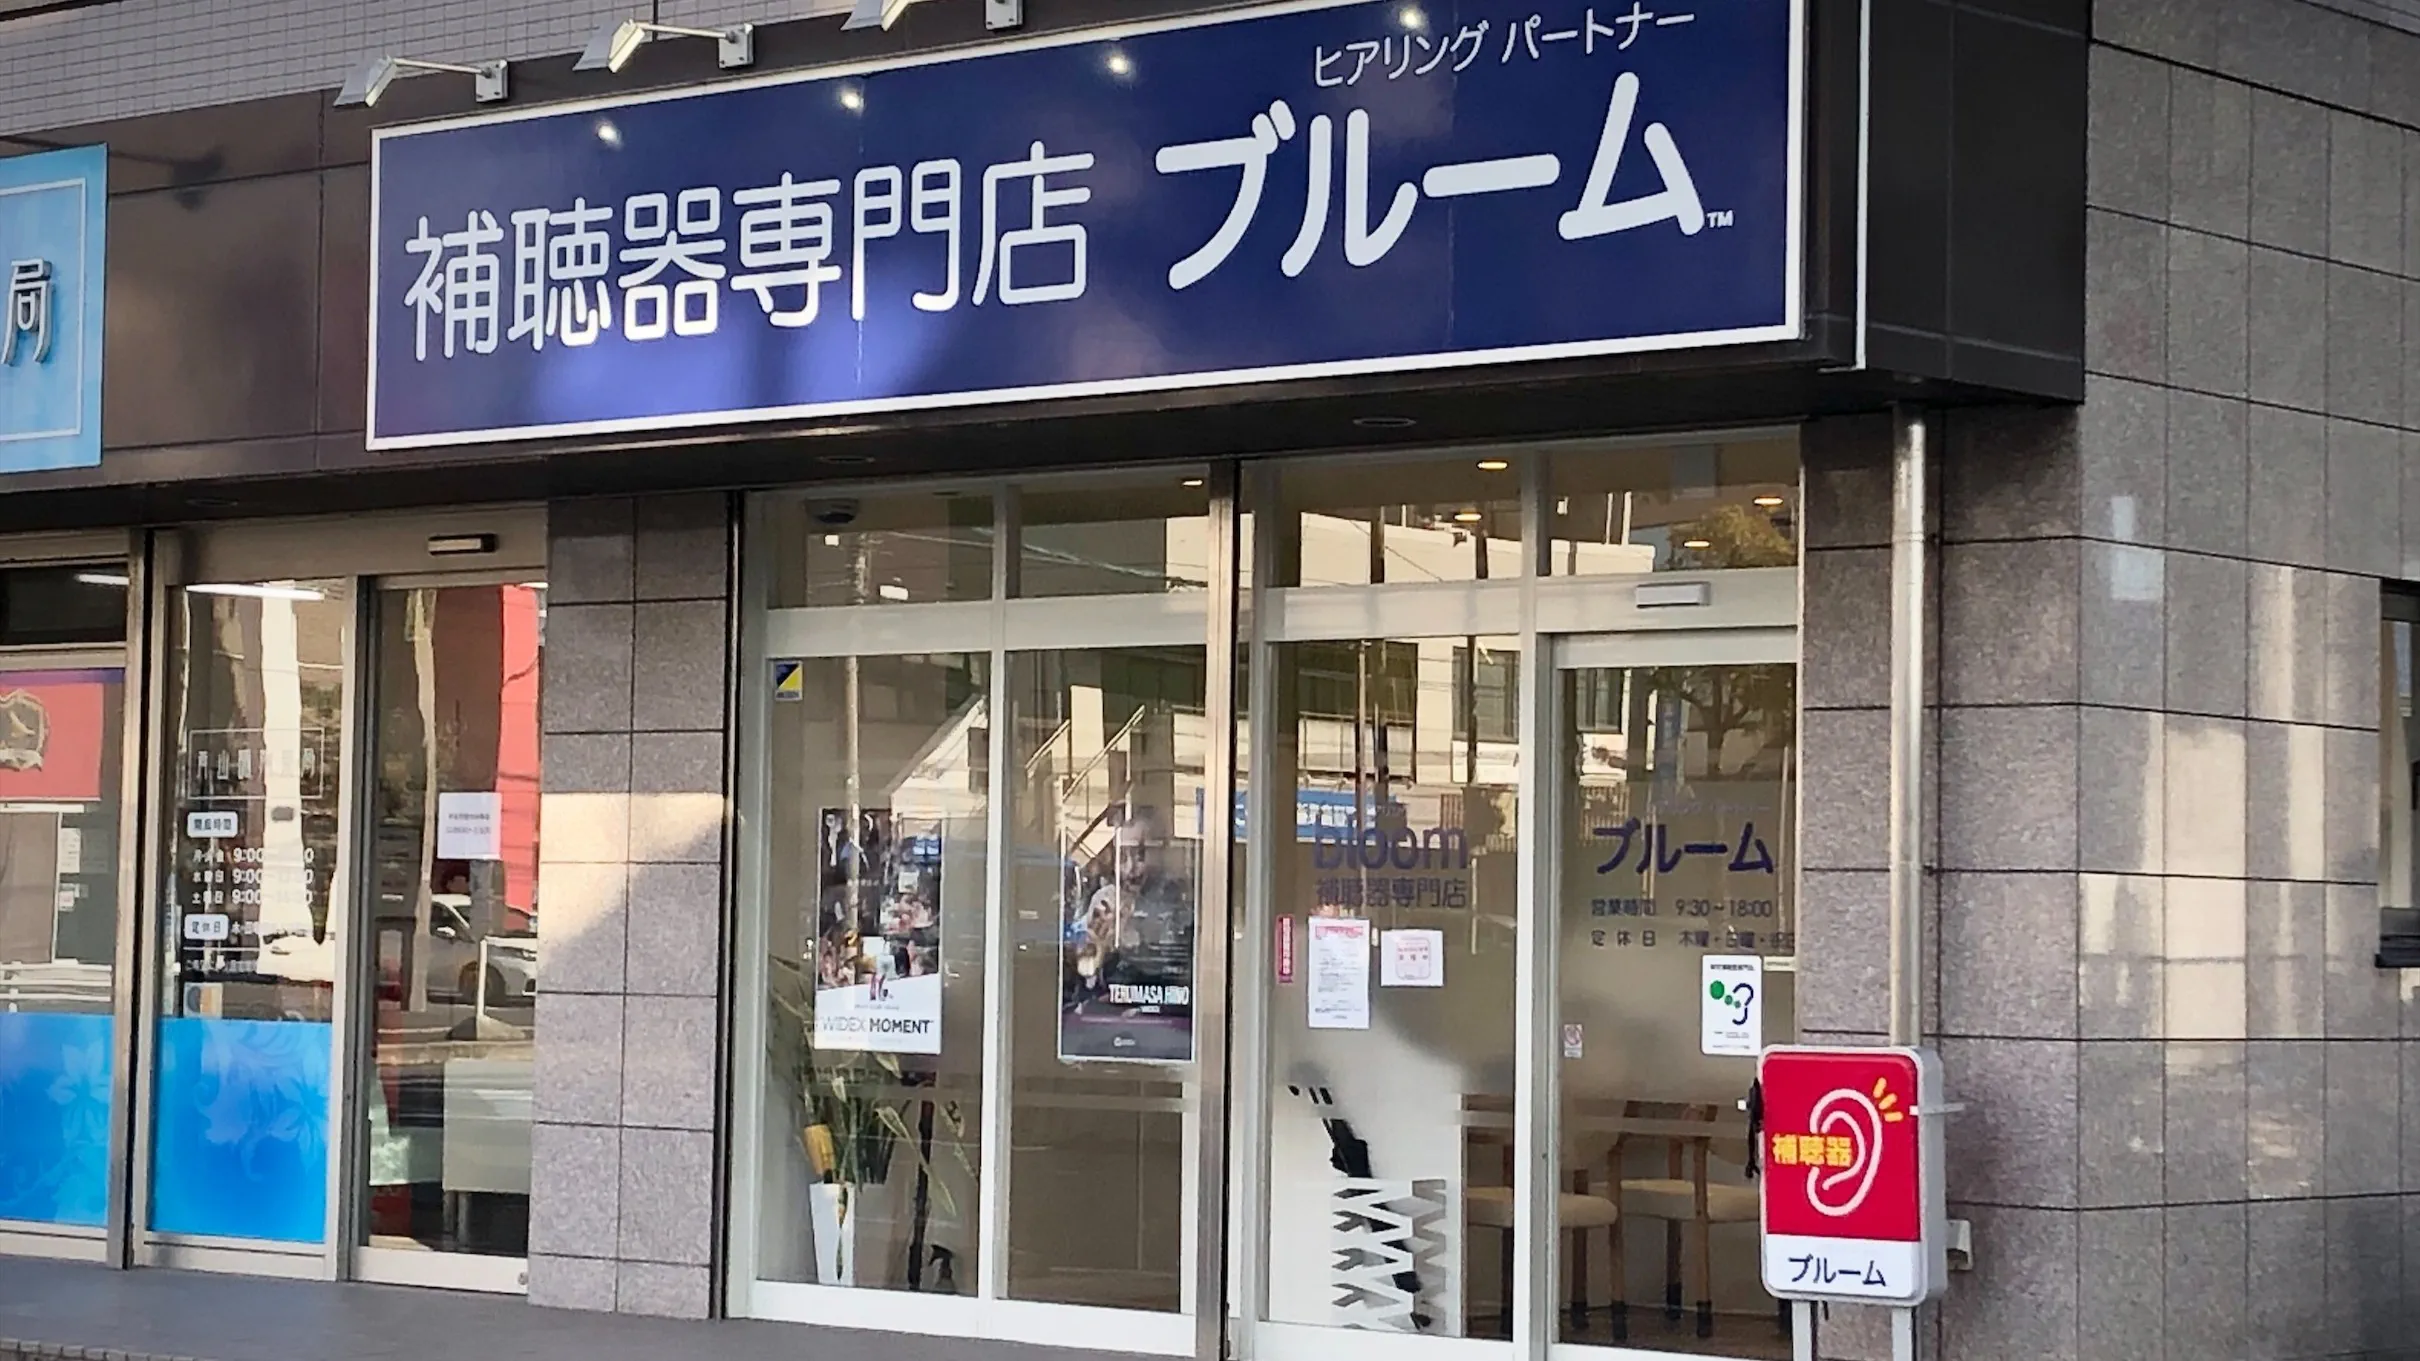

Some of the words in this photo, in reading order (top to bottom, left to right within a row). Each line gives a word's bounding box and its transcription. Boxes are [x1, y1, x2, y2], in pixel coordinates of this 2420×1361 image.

[1314, 20, 1490, 88] ヒアリング
[1501, 2, 1696, 64] パートナー
[404, 140, 1095, 361] 補聴器専門店
[1155, 71, 1703, 290] ブルーム
[2, 258, 53, 366] 局
[1313, 813, 1468, 869] bloom
[1593, 817, 1774, 874] ブルーム
[1315, 877, 1467, 908] 補聴器専門店
[1591, 899, 1656, 917] 営業時間
[1772, 1133, 1852, 1167] 補聴器
[1788, 1254, 1887, 1287] ブルーム
